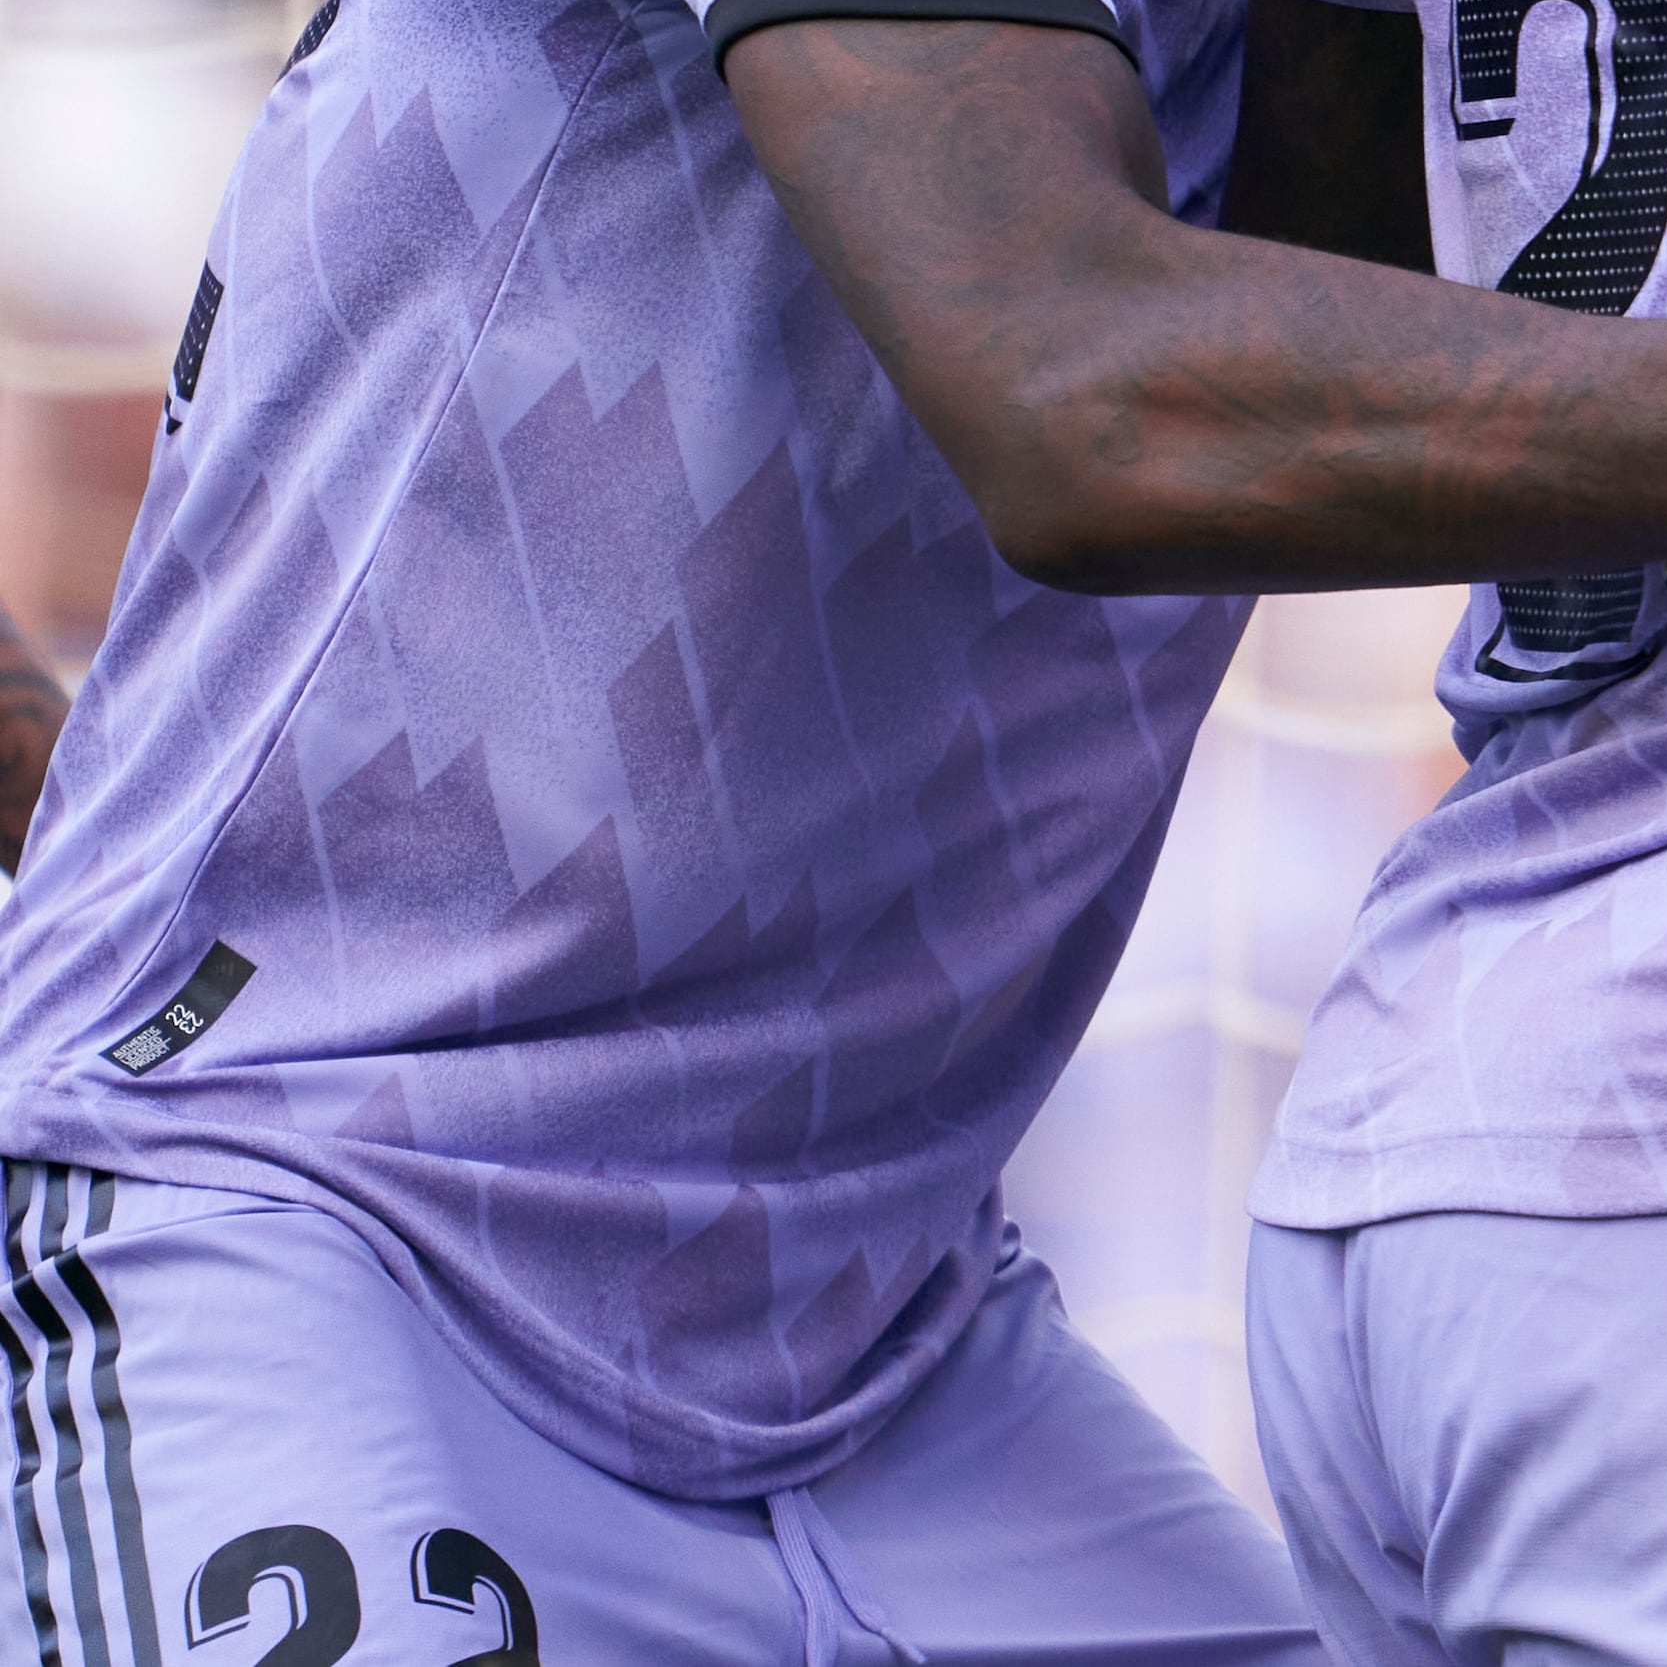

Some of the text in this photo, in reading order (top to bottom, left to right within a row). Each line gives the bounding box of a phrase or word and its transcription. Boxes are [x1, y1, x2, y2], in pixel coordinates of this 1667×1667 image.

[112, 1025, 162, 1060] AUTHENTIC
[119, 1036, 163, 1065] LICENSED
[128, 1044, 171, 1071] PRODUCT
